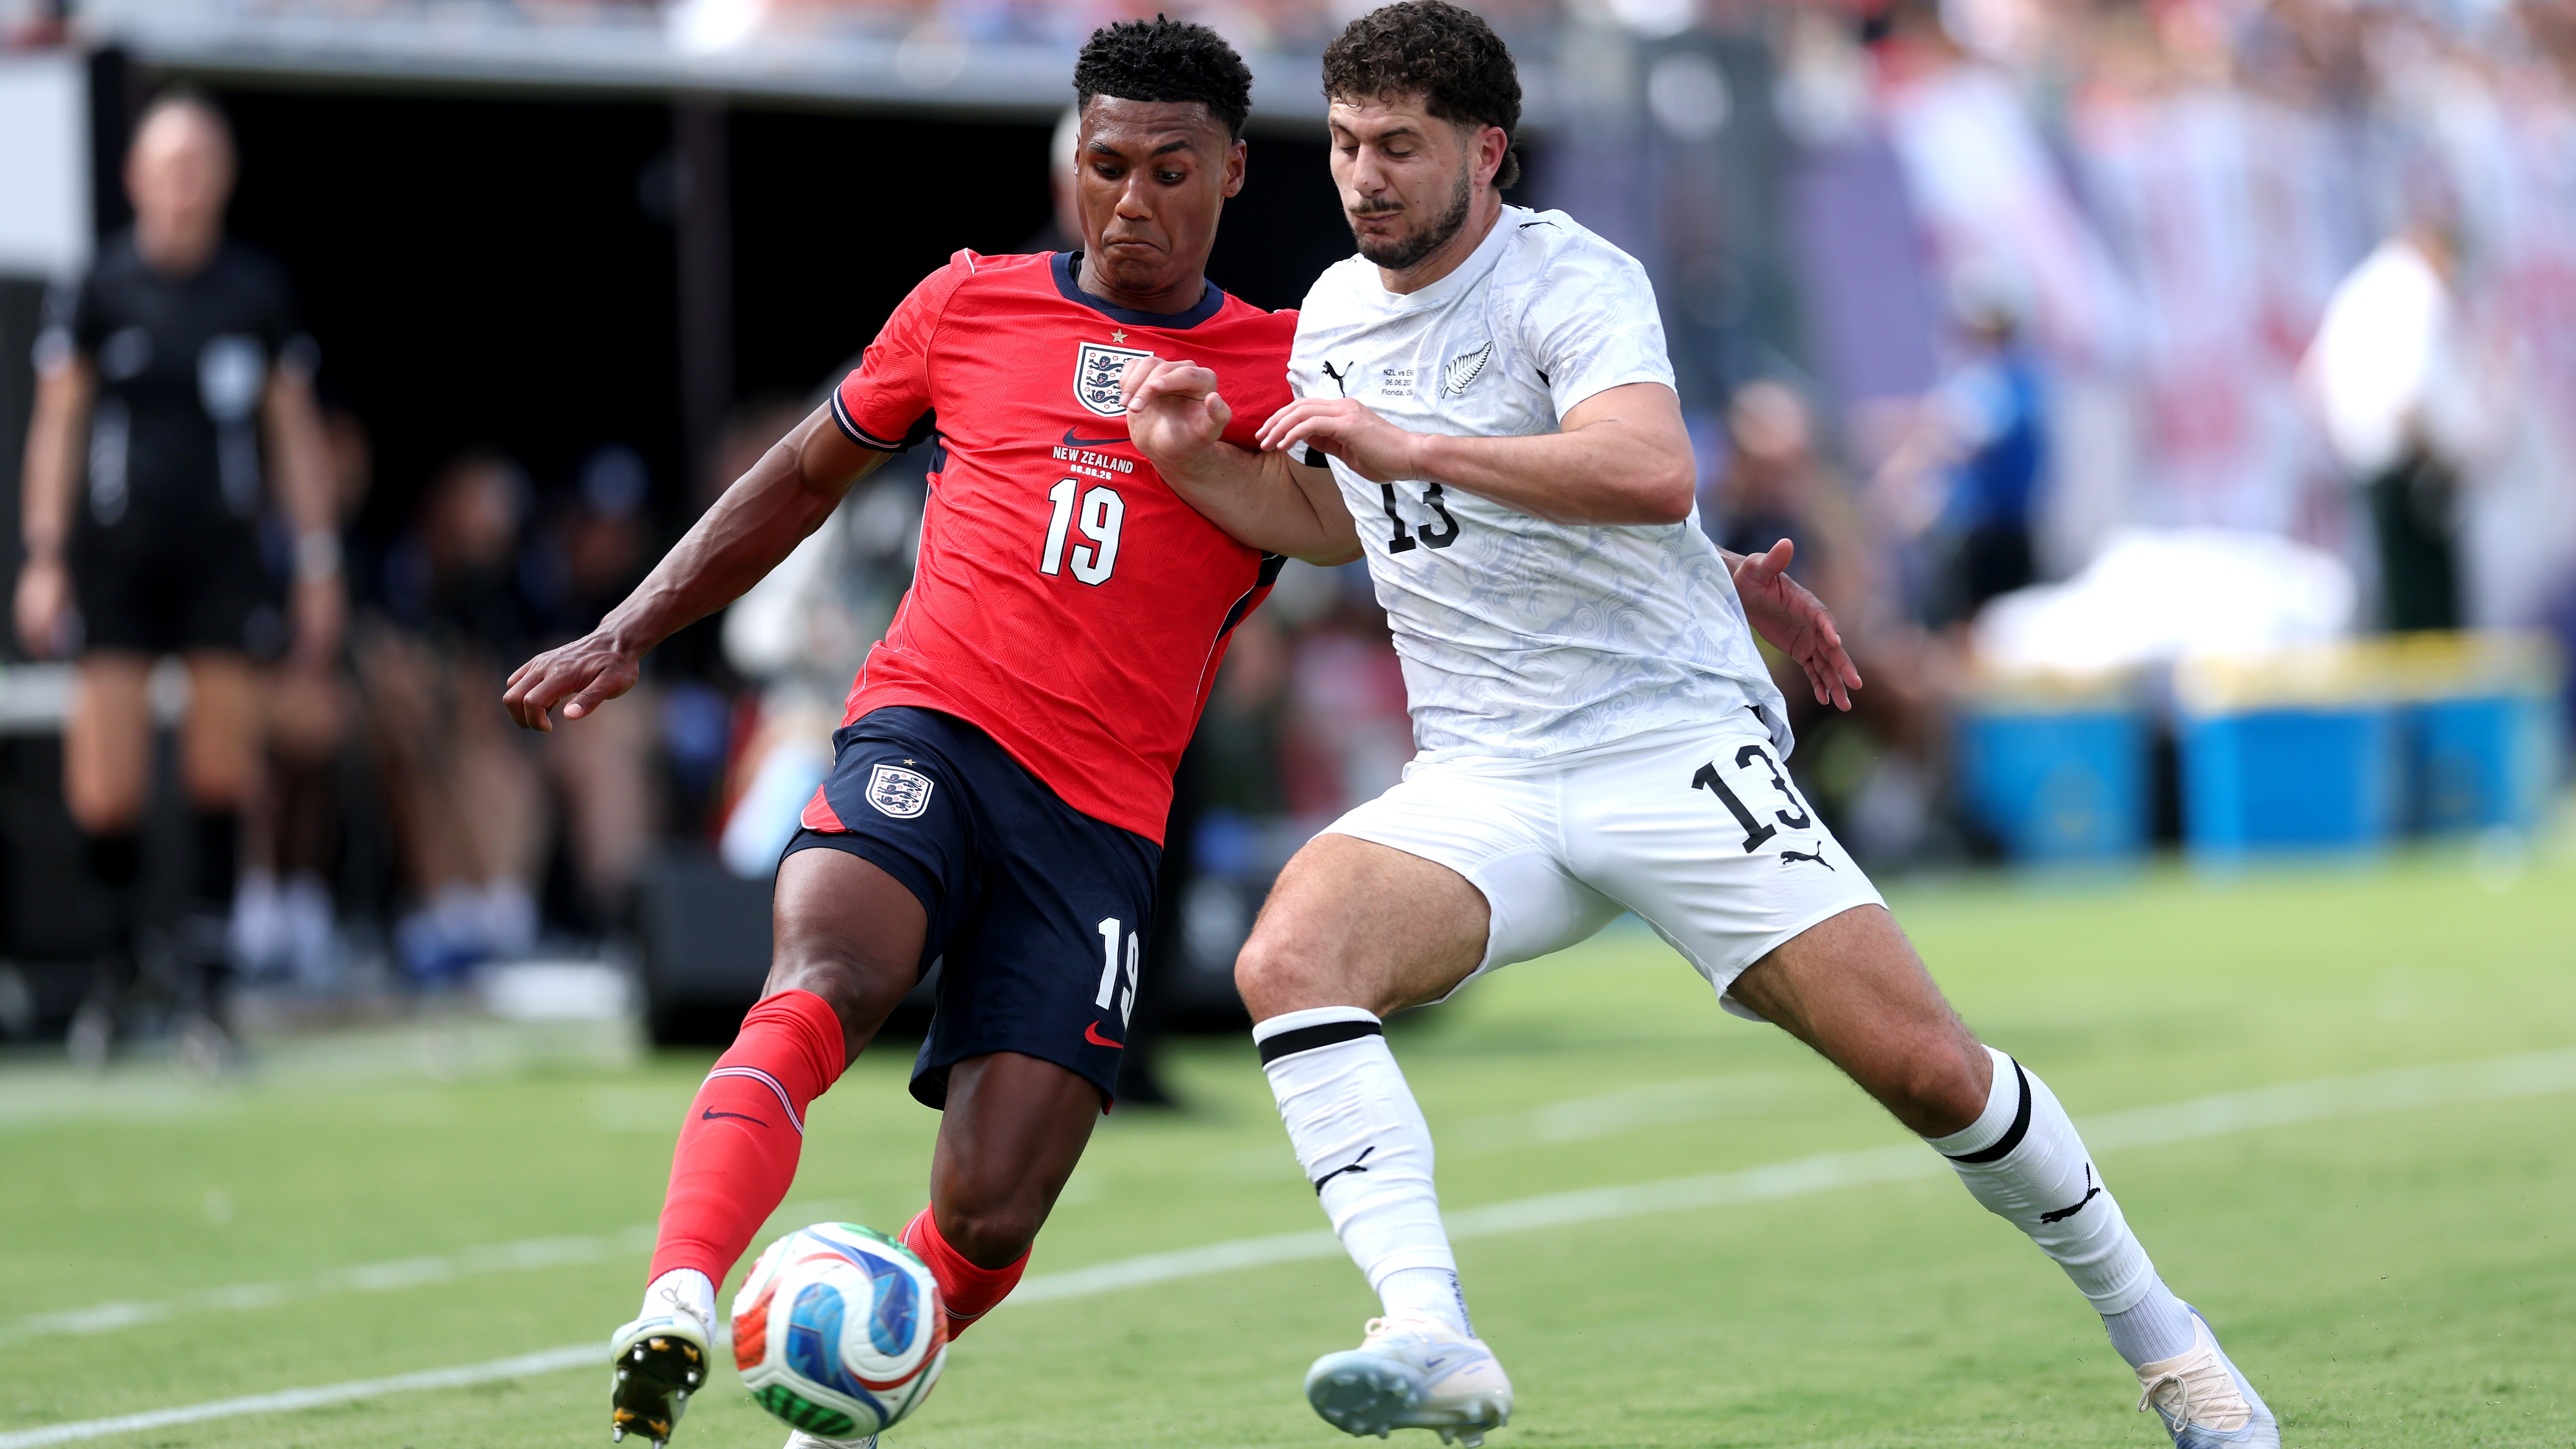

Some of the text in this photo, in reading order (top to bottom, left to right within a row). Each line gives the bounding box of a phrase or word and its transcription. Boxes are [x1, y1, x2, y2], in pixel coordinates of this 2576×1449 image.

[1053, 446, 1133, 474] NEW ZEALAND
[1070, 464, 1112, 480] 06.06.26
[1040, 477, 1126, 587] 19
[1381, 483, 1459, 554] 13
[1691, 745, 1810, 854] 13
[1095, 915, 1139, 1032] 19
